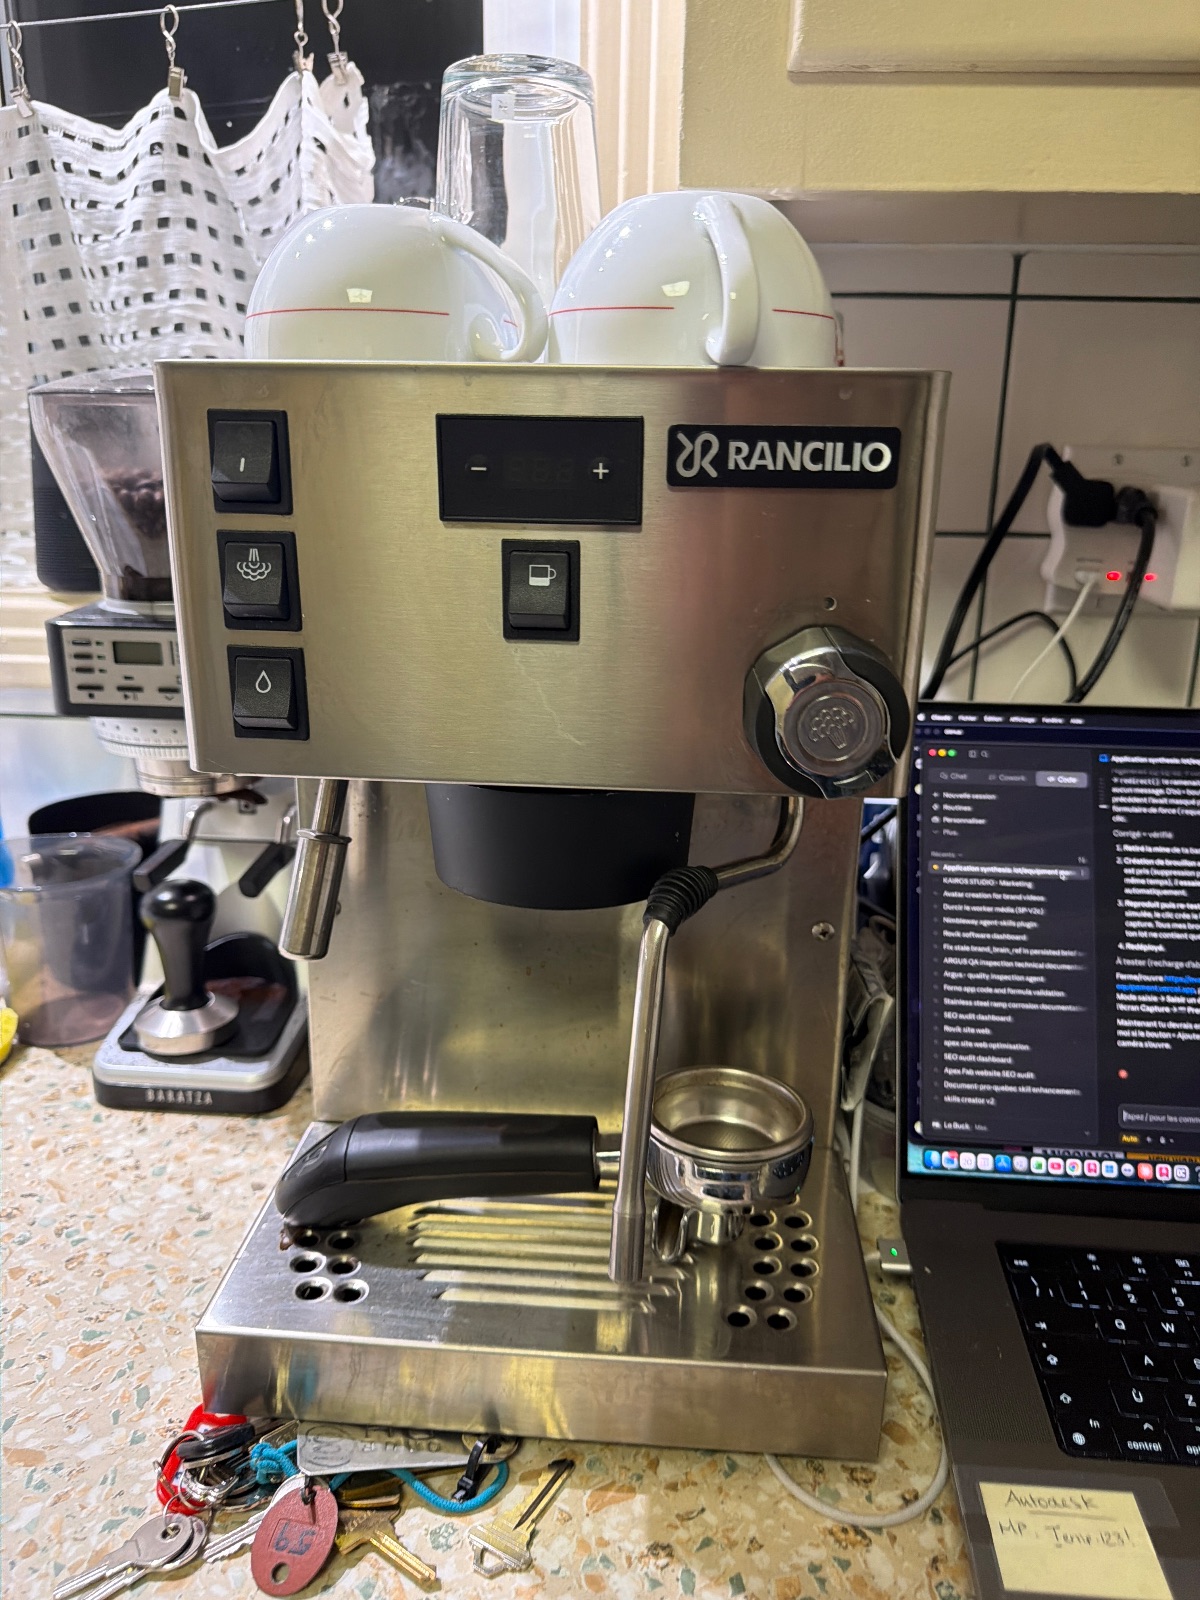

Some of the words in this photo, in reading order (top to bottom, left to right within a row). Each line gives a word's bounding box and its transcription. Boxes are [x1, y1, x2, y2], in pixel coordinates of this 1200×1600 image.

[728, 441, 892, 472] RANCILIO
[950, 772, 967, 780] Chat
[999, 773, 1026, 782] Cowork
[1058, 775, 1078, 784] Code
[1112, 786, 1132, 794] aucun
[943, 791, 971, 800] Nouvelle
[972, 793, 996, 801] session
[943, 803, 971, 812] Routines
[1112, 805, 1147, 813] formulaire
[943, 816, 985, 825] Personnaliser
[943, 828, 957, 837] Plus
[1165, 859, 1196, 867] brouillon
[943, 864, 979, 872] Application
[980, 866, 1011, 874] synthesis
[1124, 867, 1134, 875] est
[943, 877, 968, 885] KAIROS
[969, 878, 994, 886] STUDIO
[999, 880, 1032, 889] Marketing
[943, 890, 964, 898] Avatar
[965, 892, 991, 900] creation
[993, 892, 1002, 900] for
[1003, 893, 1021, 901] brand
[1022, 894, 1045, 902] videos
[971, 905, 993, 913] worker
[1017, 921, 1037, 929] plugin
[1172, 922, 1186, 930] mes
[962, 931, 990, 940] software
[992, 932, 1026, 941] dashboard
[943, 942, 953, 951] Fix
[954, 944, 970, 952] stale
[1030, 948, 1060, 957] persisted
[944, 957, 967, 965] ARGUS
[980, 959, 1013, 968] inspection
[1015, 961, 1044, 969] technical
[1148, 959, 1184, 969] (recharge
[944, 971, 962, 979] Argus
[967, 972, 989, 981] quality
[991, 973, 1024, 982] inspection
[1026, 975, 1044, 984] agent
[963, 986, 975, 994] app
[977, 986, 992, 994] code
[994, 987, 1006, 995] and
[1007, 987, 1032, 996] formula
[1033, 989, 1064, 998] validation
[1116, 993, 1137, 1001] Mode
[944, 998, 972, 1006] Stainless
[974, 999, 989, 1008] steel
[990, 1001, 1007, 1009] ramp
[1008, 1002, 1038, 1010] corrosion
[1140, 1004, 1170, 1013] Capture
[944, 1011, 957, 1020] SEO
[959, 1012, 975, 1021] audit
[976, 1014, 1012, 1022] dashboard
[1117, 1019, 1157, 1028] Maintenant
[1167, 1021, 1193, 1029] devrais
[963, 1026, 974, 1034] site
[976, 1027, 990, 1035] web
[1117, 1029, 1130, 1037] moi
[1146, 1031, 1171, 1039] bouton
[944, 1039, 959, 1048] apex
[961, 1040, 973, 1048] site
[974, 1041, 988, 1049] web
[989, 1042, 1029, 1051] optimisation
[944, 1052, 957, 1061] SEO
[959, 1054, 975, 1062] audit
[976, 1055, 1012, 1064] dashboard
[944, 1067, 961, 1075] Apex
[962, 1068, 974, 1076] Fab
[975, 1069, 1000, 1078] website
[1002, 1070, 1015, 1078] SEO
[1017, 1071, 1034, 1080] audit
[1018, 1085, 1031, 1093] skill
[145, 1088, 213, 1106] BARATZA
[944, 1095, 960, 1103] skills
[961, 1096, 984, 1105] creator
[1149, 1114, 1166, 1123] pour
[1122, 1134, 1138, 1143] Auto
[1127, 1293, 1138, 1304] 2
[1174, 1296, 1185, 1307] 3
[1114, 1319, 1126, 1331] Q
[1160, 1321, 1175, 1334] W
[1143, 1355, 1154, 1367] A
[1184, 1394, 1197, 1408] Z
[1127, 1440, 1162, 1452] control
[1005, 1488, 1099, 1511] Autodesk
